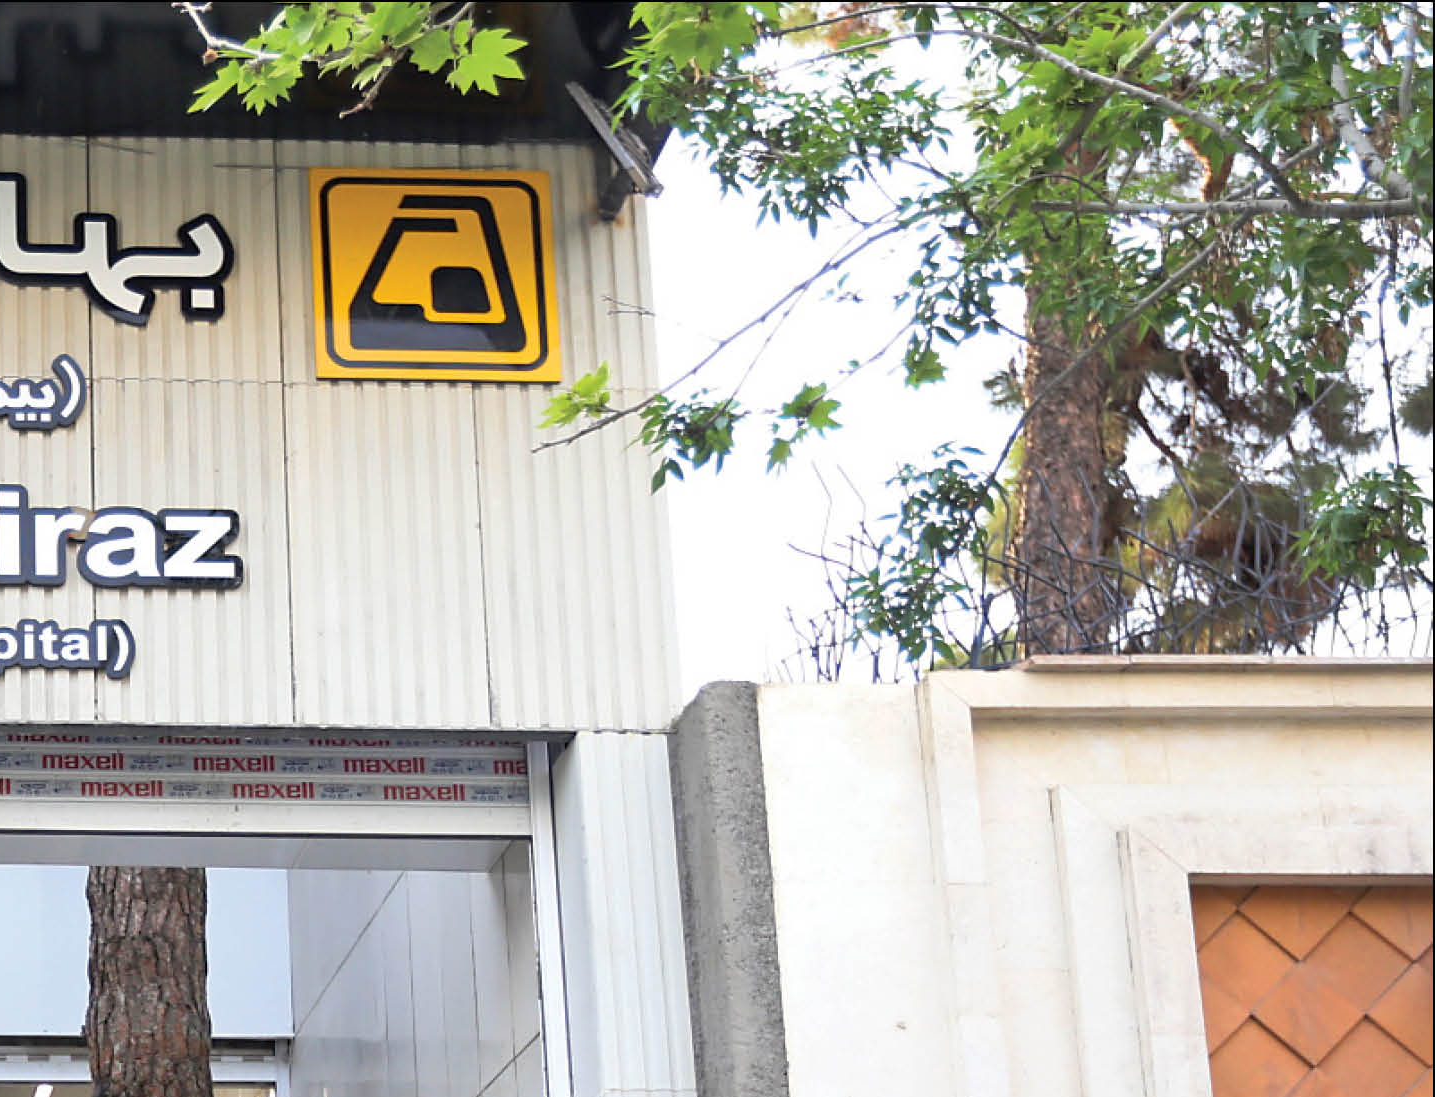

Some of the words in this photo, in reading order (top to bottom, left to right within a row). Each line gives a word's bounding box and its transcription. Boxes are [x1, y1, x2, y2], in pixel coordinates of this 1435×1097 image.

[41, 754, 126, 770] maxell
[194, 756, 275, 773] maxell
[343, 757, 425, 775] maxell
[80, 781, 166, 798] maxell
[232, 782, 316, 800] maxell
[383, 783, 466, 801] maxell
